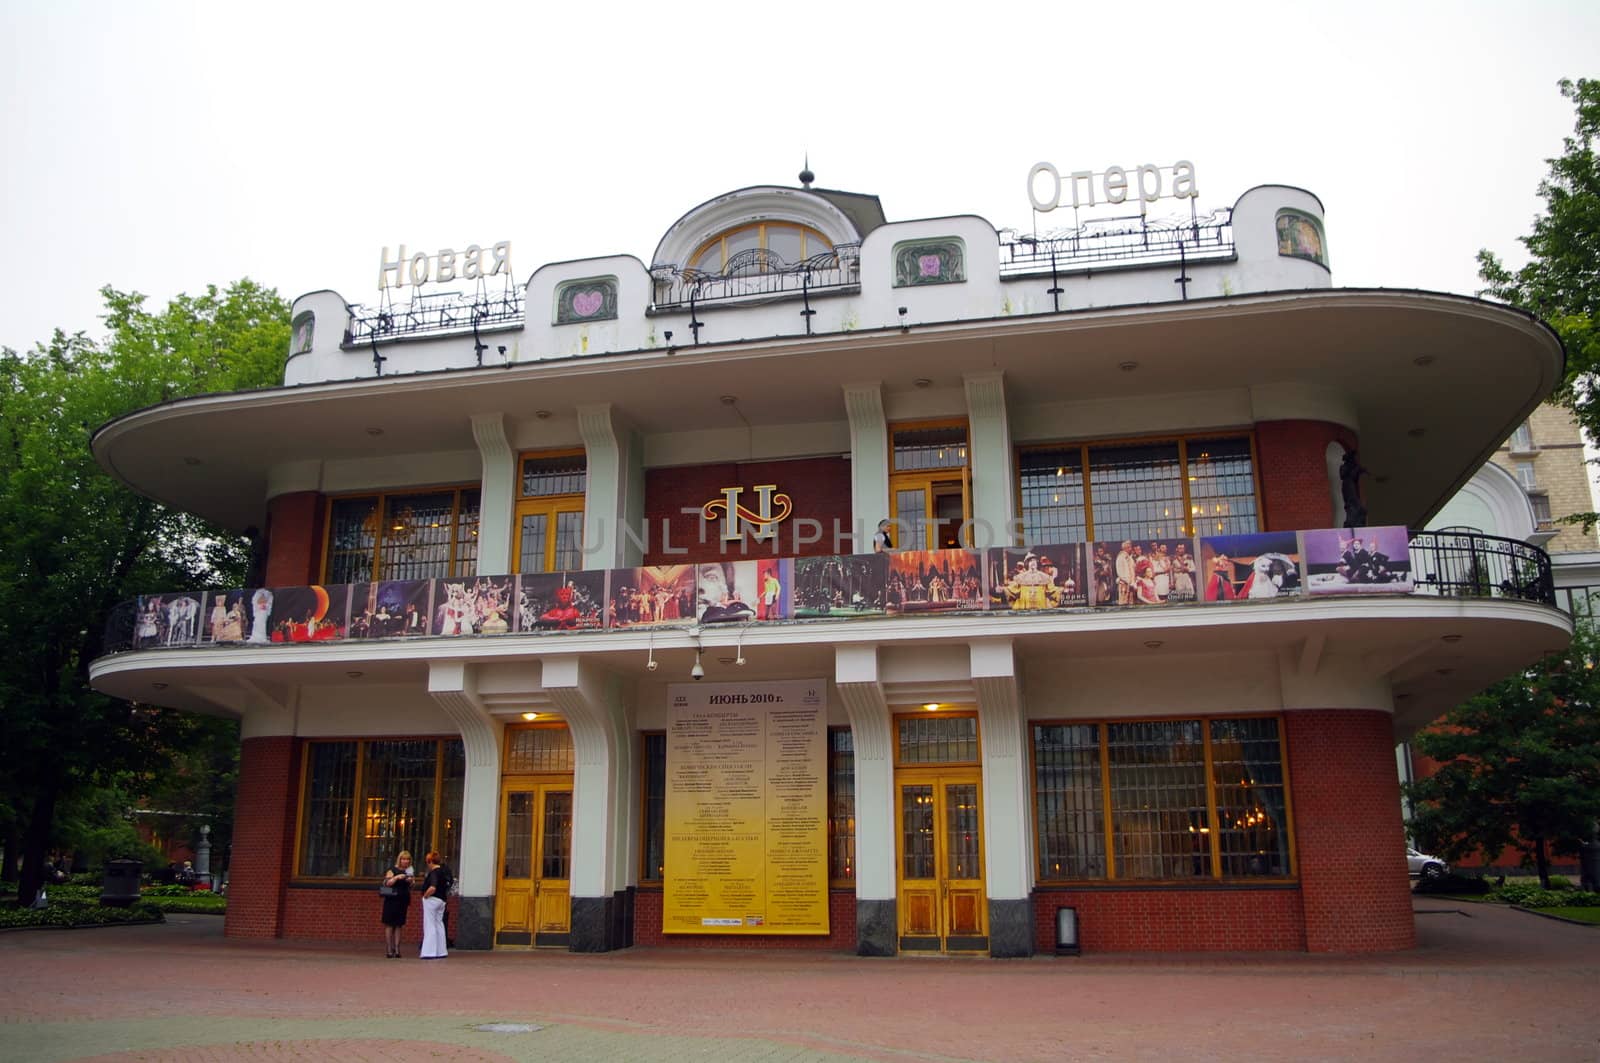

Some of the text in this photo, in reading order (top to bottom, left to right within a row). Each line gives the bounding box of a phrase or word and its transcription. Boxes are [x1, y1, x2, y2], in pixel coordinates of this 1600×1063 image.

[1027, 160, 1199, 216] Опера
[377, 240, 512, 291] Новая
[709, 693, 784, 705] ИЮНЬ 2010 г.
